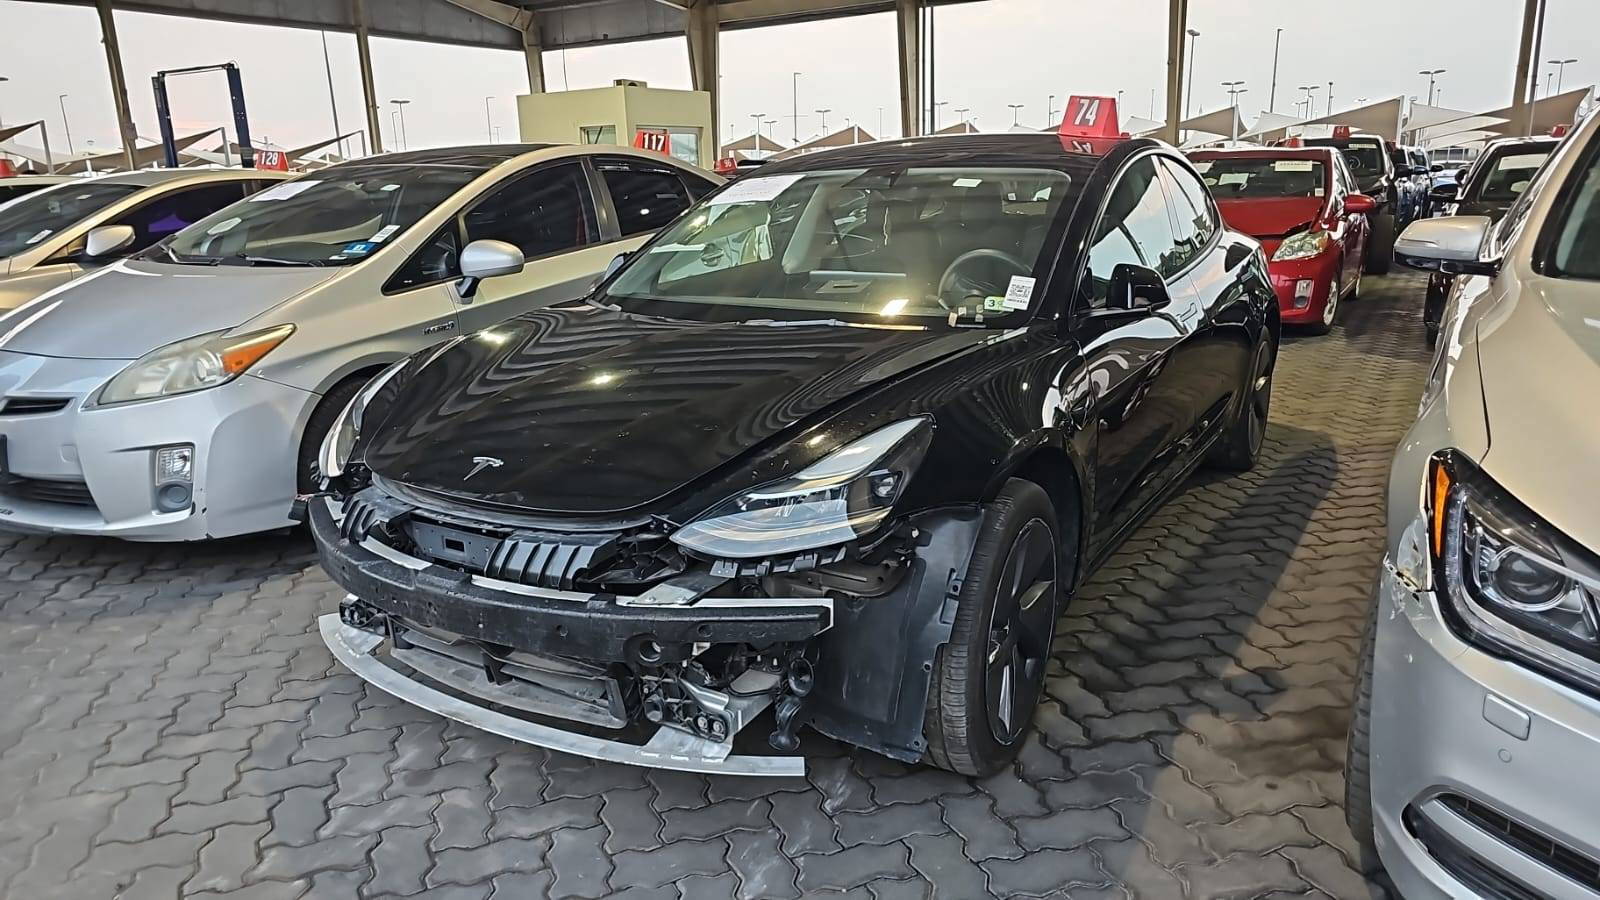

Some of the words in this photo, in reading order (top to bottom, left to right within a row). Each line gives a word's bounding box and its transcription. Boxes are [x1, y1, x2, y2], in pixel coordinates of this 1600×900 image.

[1074, 98, 1100, 126] 74
[643, 132, 665, 151] 117
[261, 151, 279, 166] 128
[988, 299, 995, 307] 3
